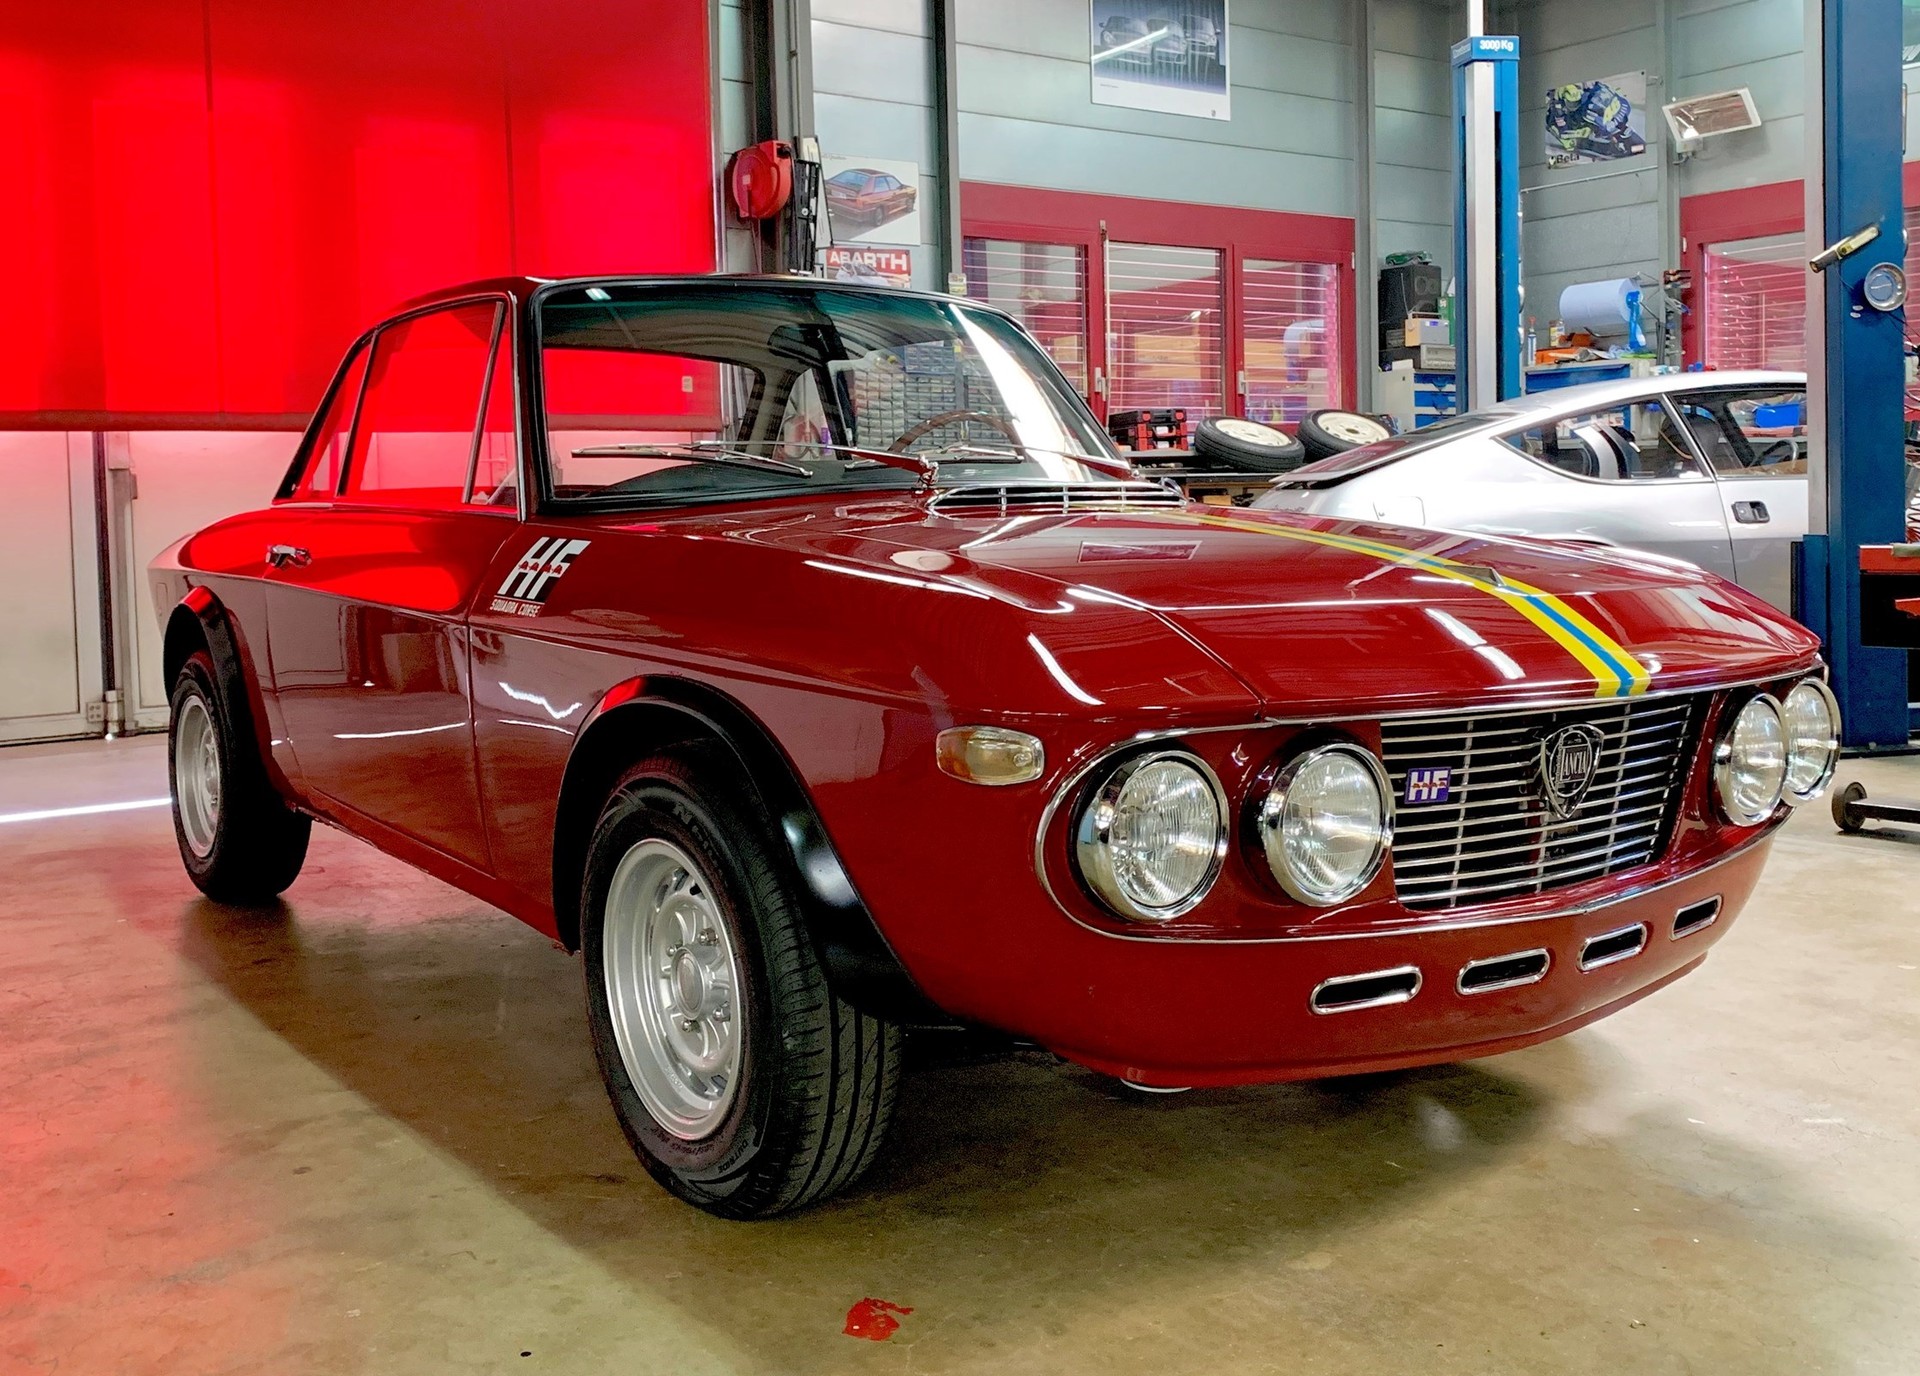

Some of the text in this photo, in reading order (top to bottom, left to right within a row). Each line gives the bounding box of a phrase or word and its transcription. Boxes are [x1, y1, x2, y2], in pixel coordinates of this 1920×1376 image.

[1479, 39, 1500, 51] 3000
[1501, 40, 1514, 52] Kg
[1557, 153, 1580, 163] Beta
[830, 251, 908, 271] ABARTH
[497, 536, 592, 600] HF
[517, 603, 541, 618] CORSE
[1559, 747, 1588, 782] LANCIA
[1408, 769, 1449, 801] HF
